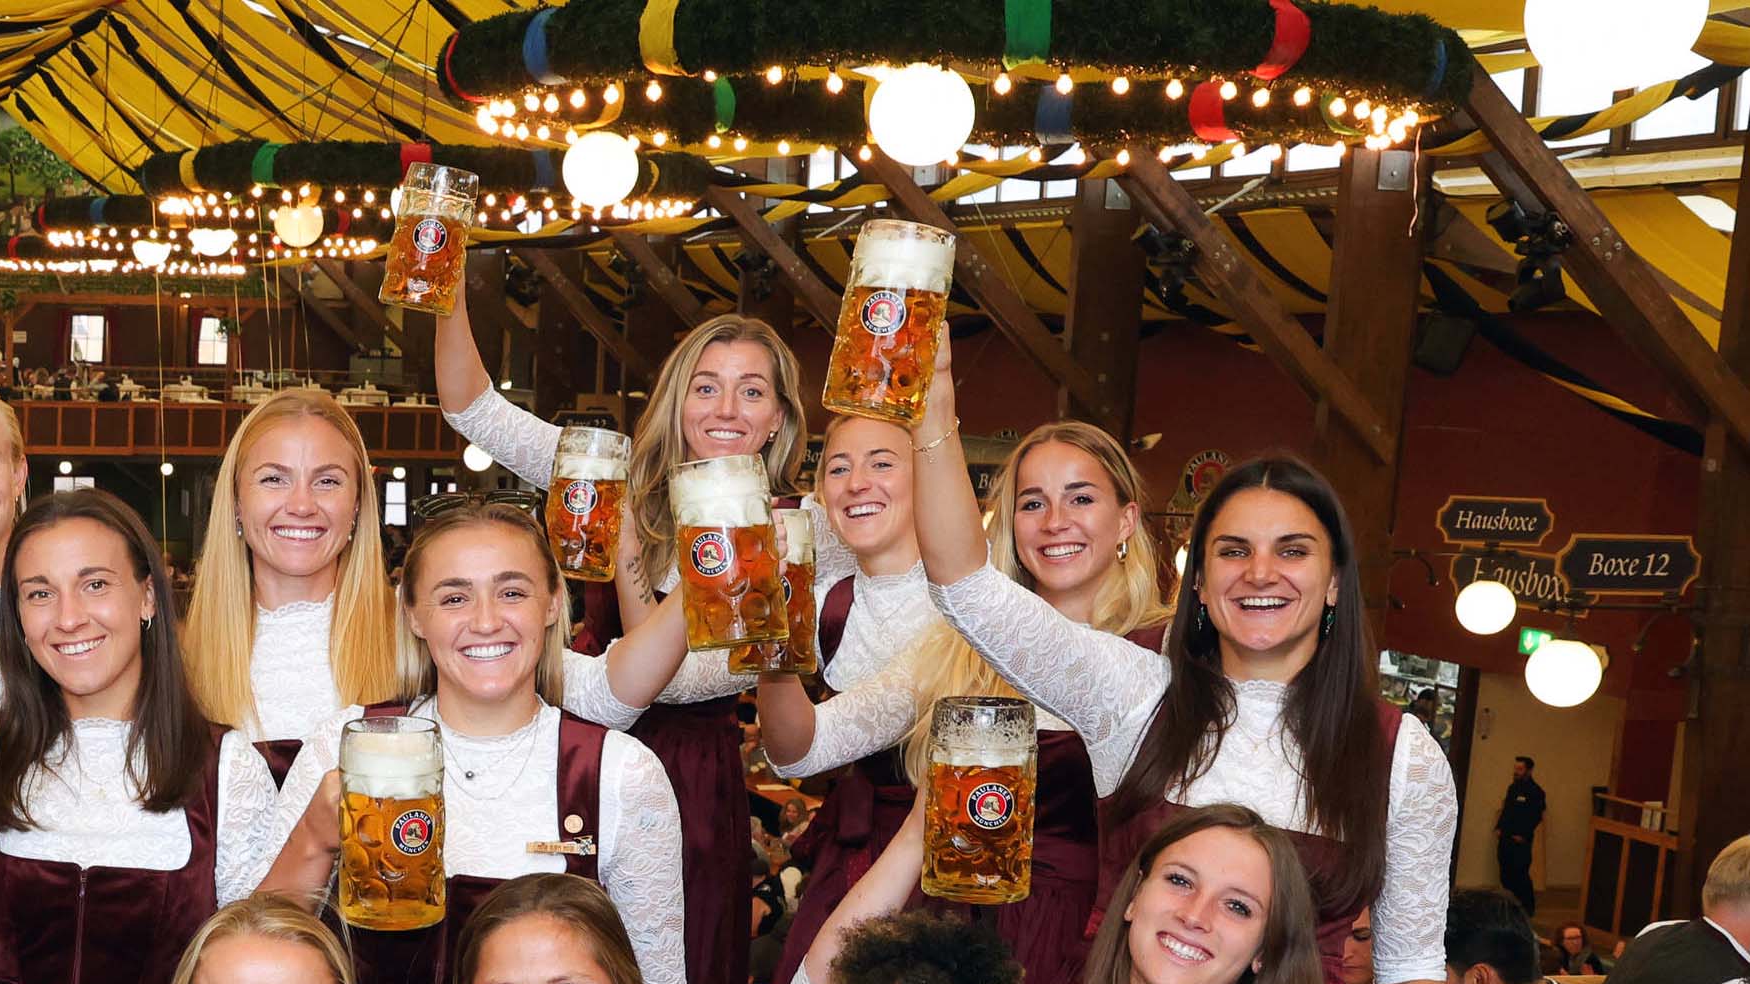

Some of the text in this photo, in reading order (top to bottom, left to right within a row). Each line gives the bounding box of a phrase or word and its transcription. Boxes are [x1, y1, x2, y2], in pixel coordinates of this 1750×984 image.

[1455, 508, 1537, 531] Hausboxe
[1587, 552, 1670, 576] Boxe 12
[972, 785, 1011, 800] PAULANER
[394, 811, 432, 830] PAULANER
